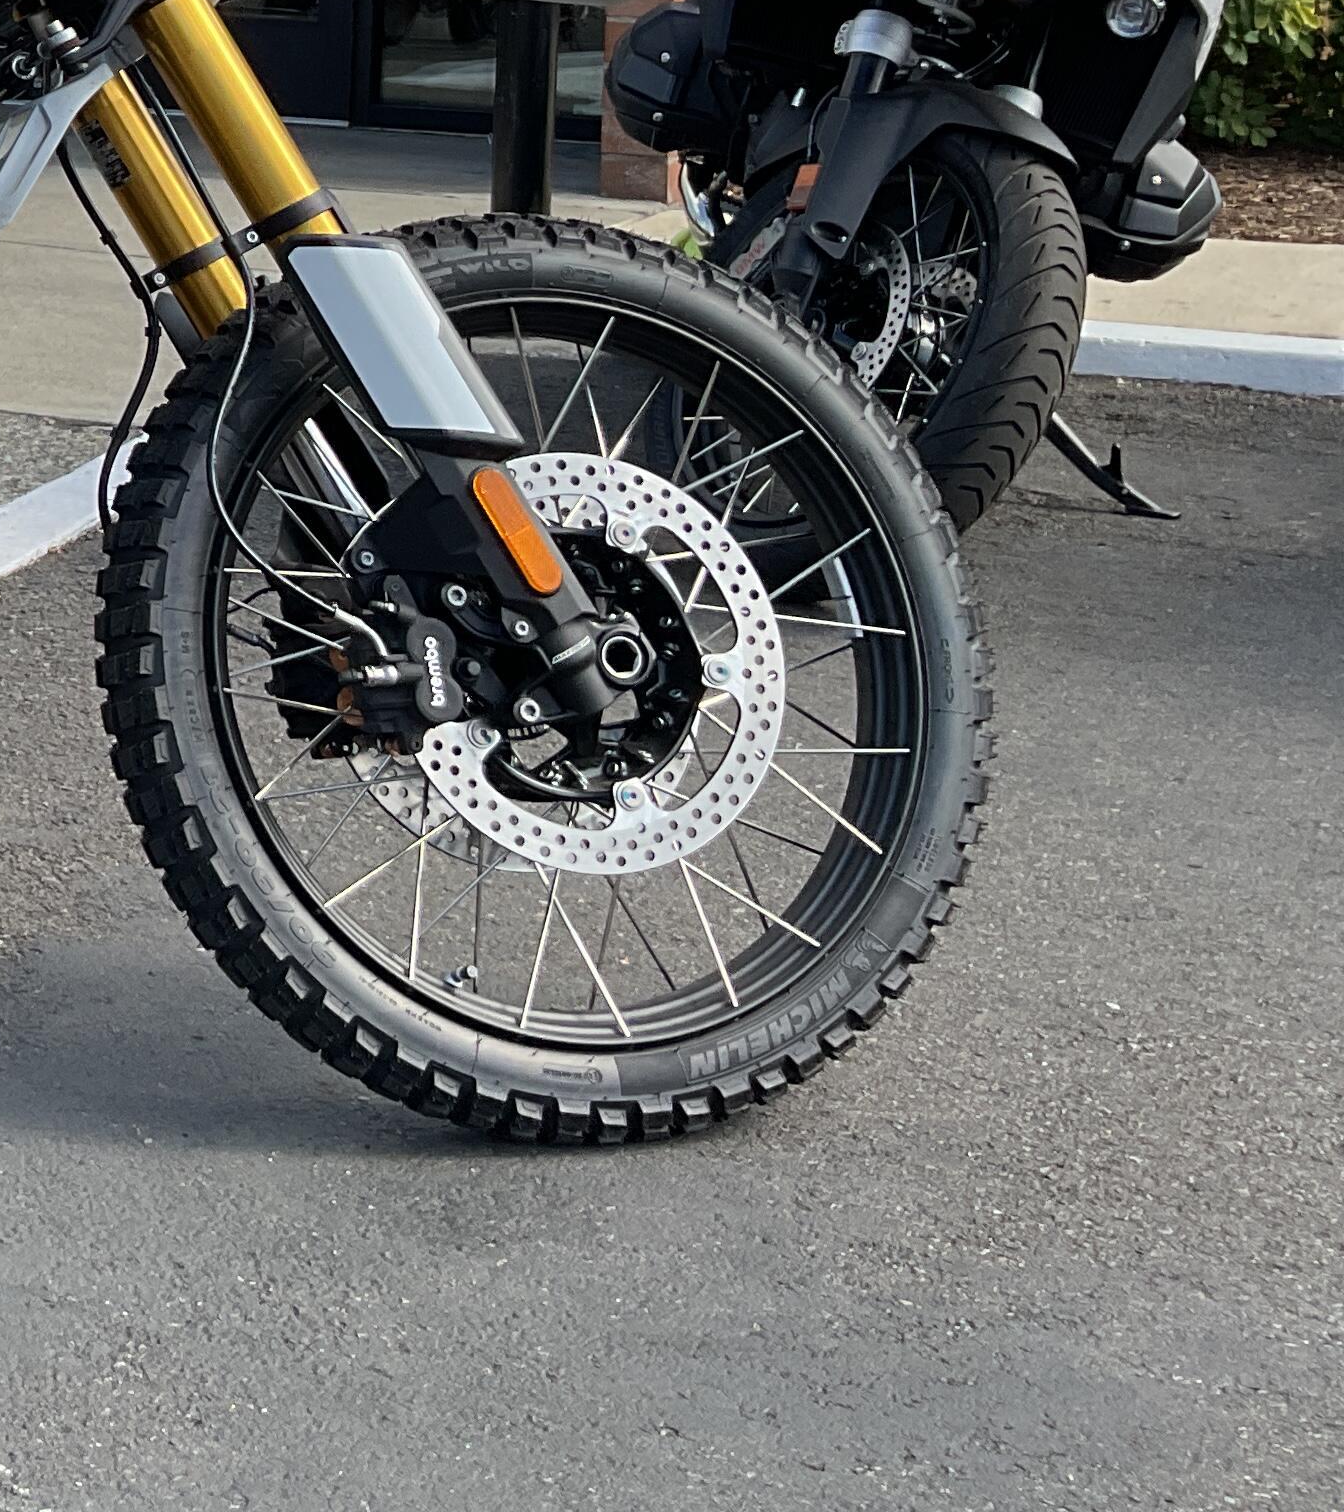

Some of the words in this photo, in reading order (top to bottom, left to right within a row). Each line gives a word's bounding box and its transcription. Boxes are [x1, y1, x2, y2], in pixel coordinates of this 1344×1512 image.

[457, 258, 530, 275] WILD
[424, 636, 448, 707] brembo
[689, 969, 852, 1079] MICHELIN
